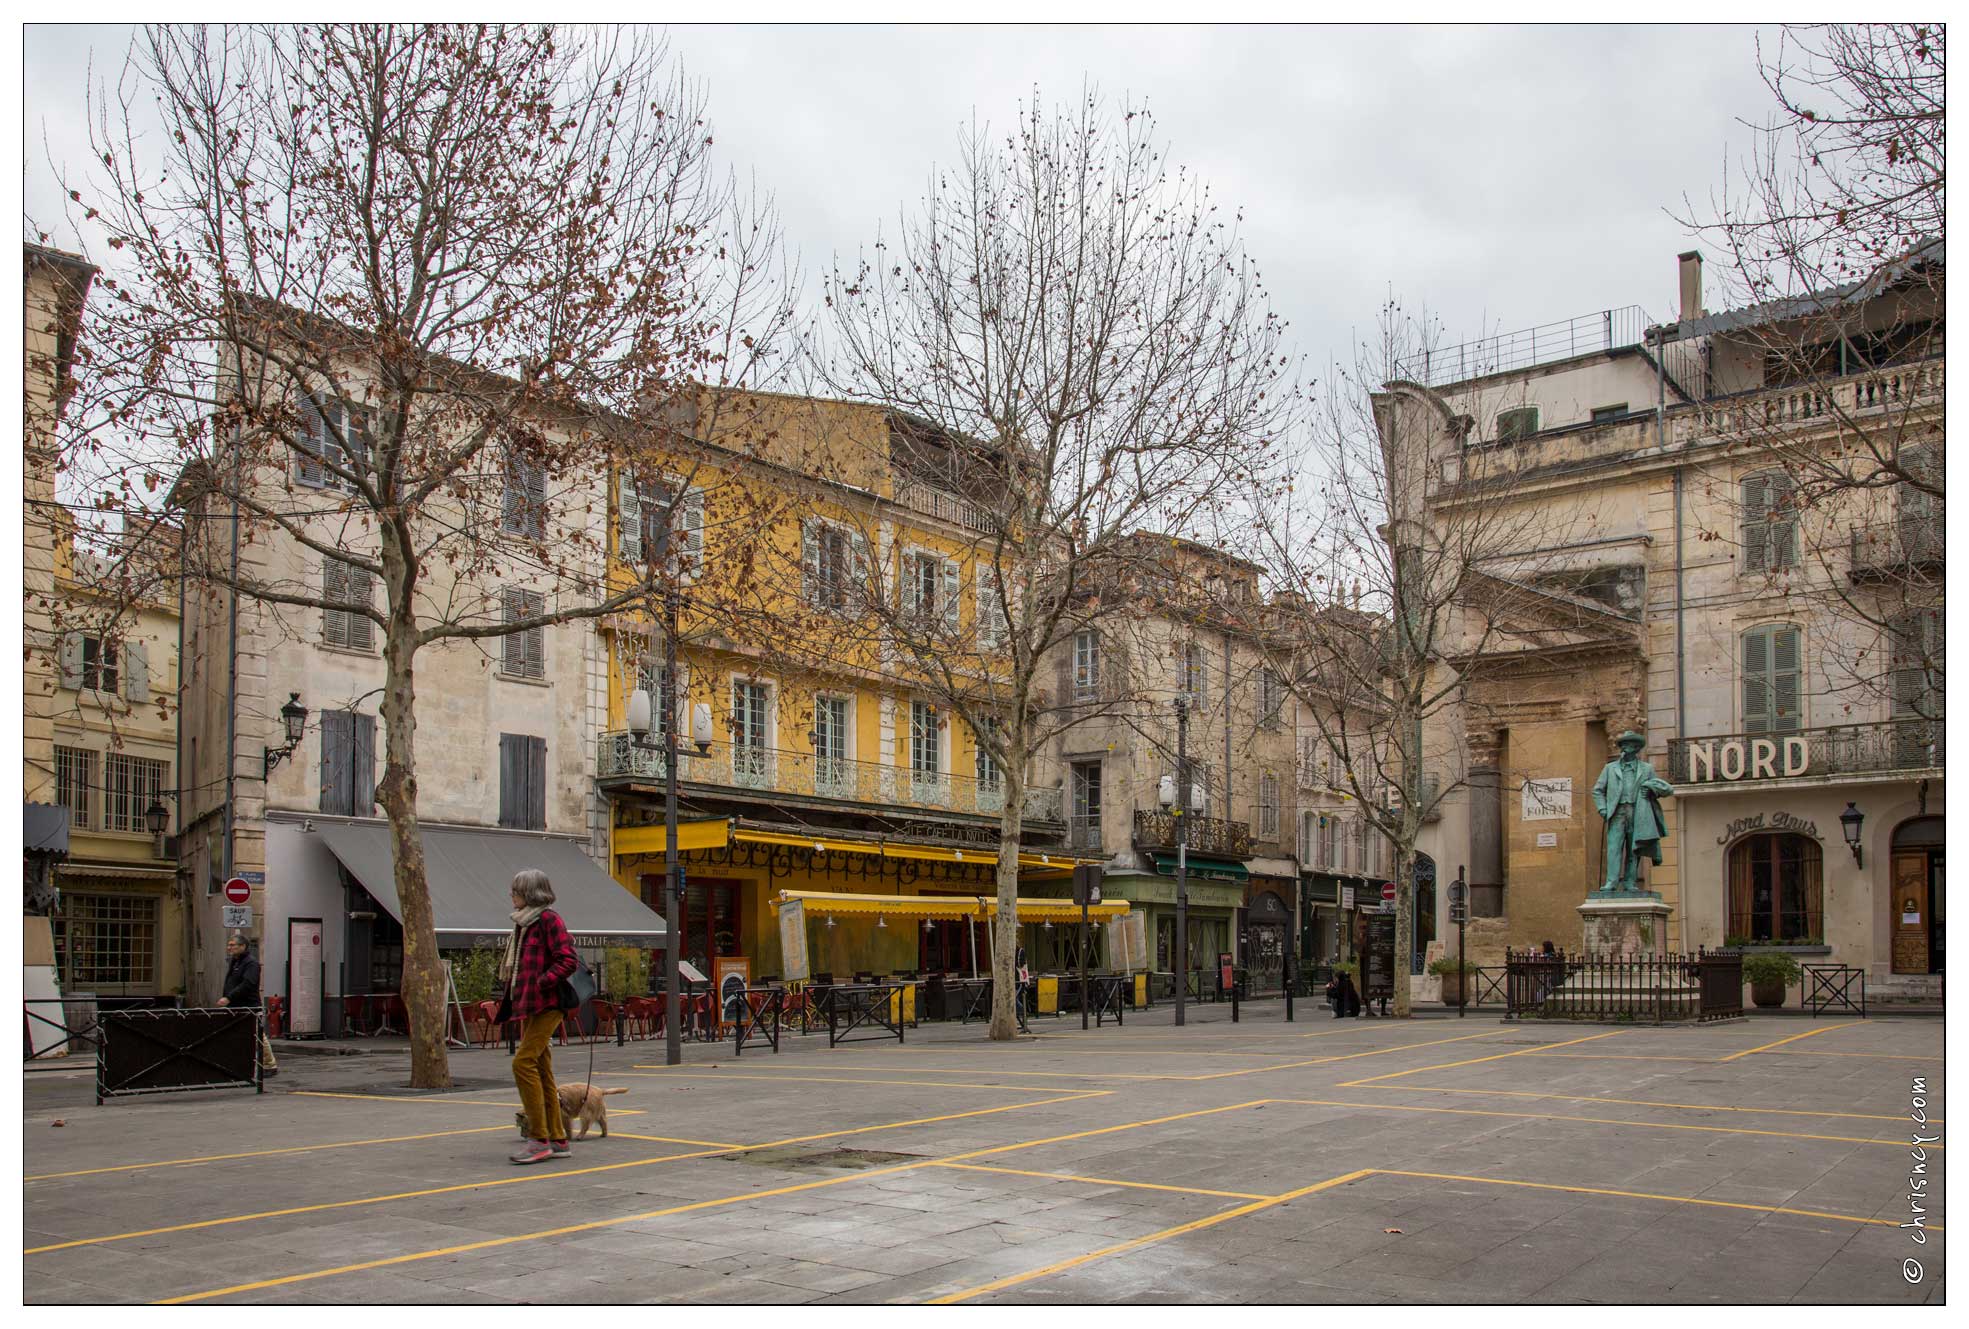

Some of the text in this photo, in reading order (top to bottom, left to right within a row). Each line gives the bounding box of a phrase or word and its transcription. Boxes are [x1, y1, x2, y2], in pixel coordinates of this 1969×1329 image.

[1689, 736, 1809, 783] NORD
[1717, 811, 1825, 845] Nord Pinus
[229, 907, 247, 915] SAUF
